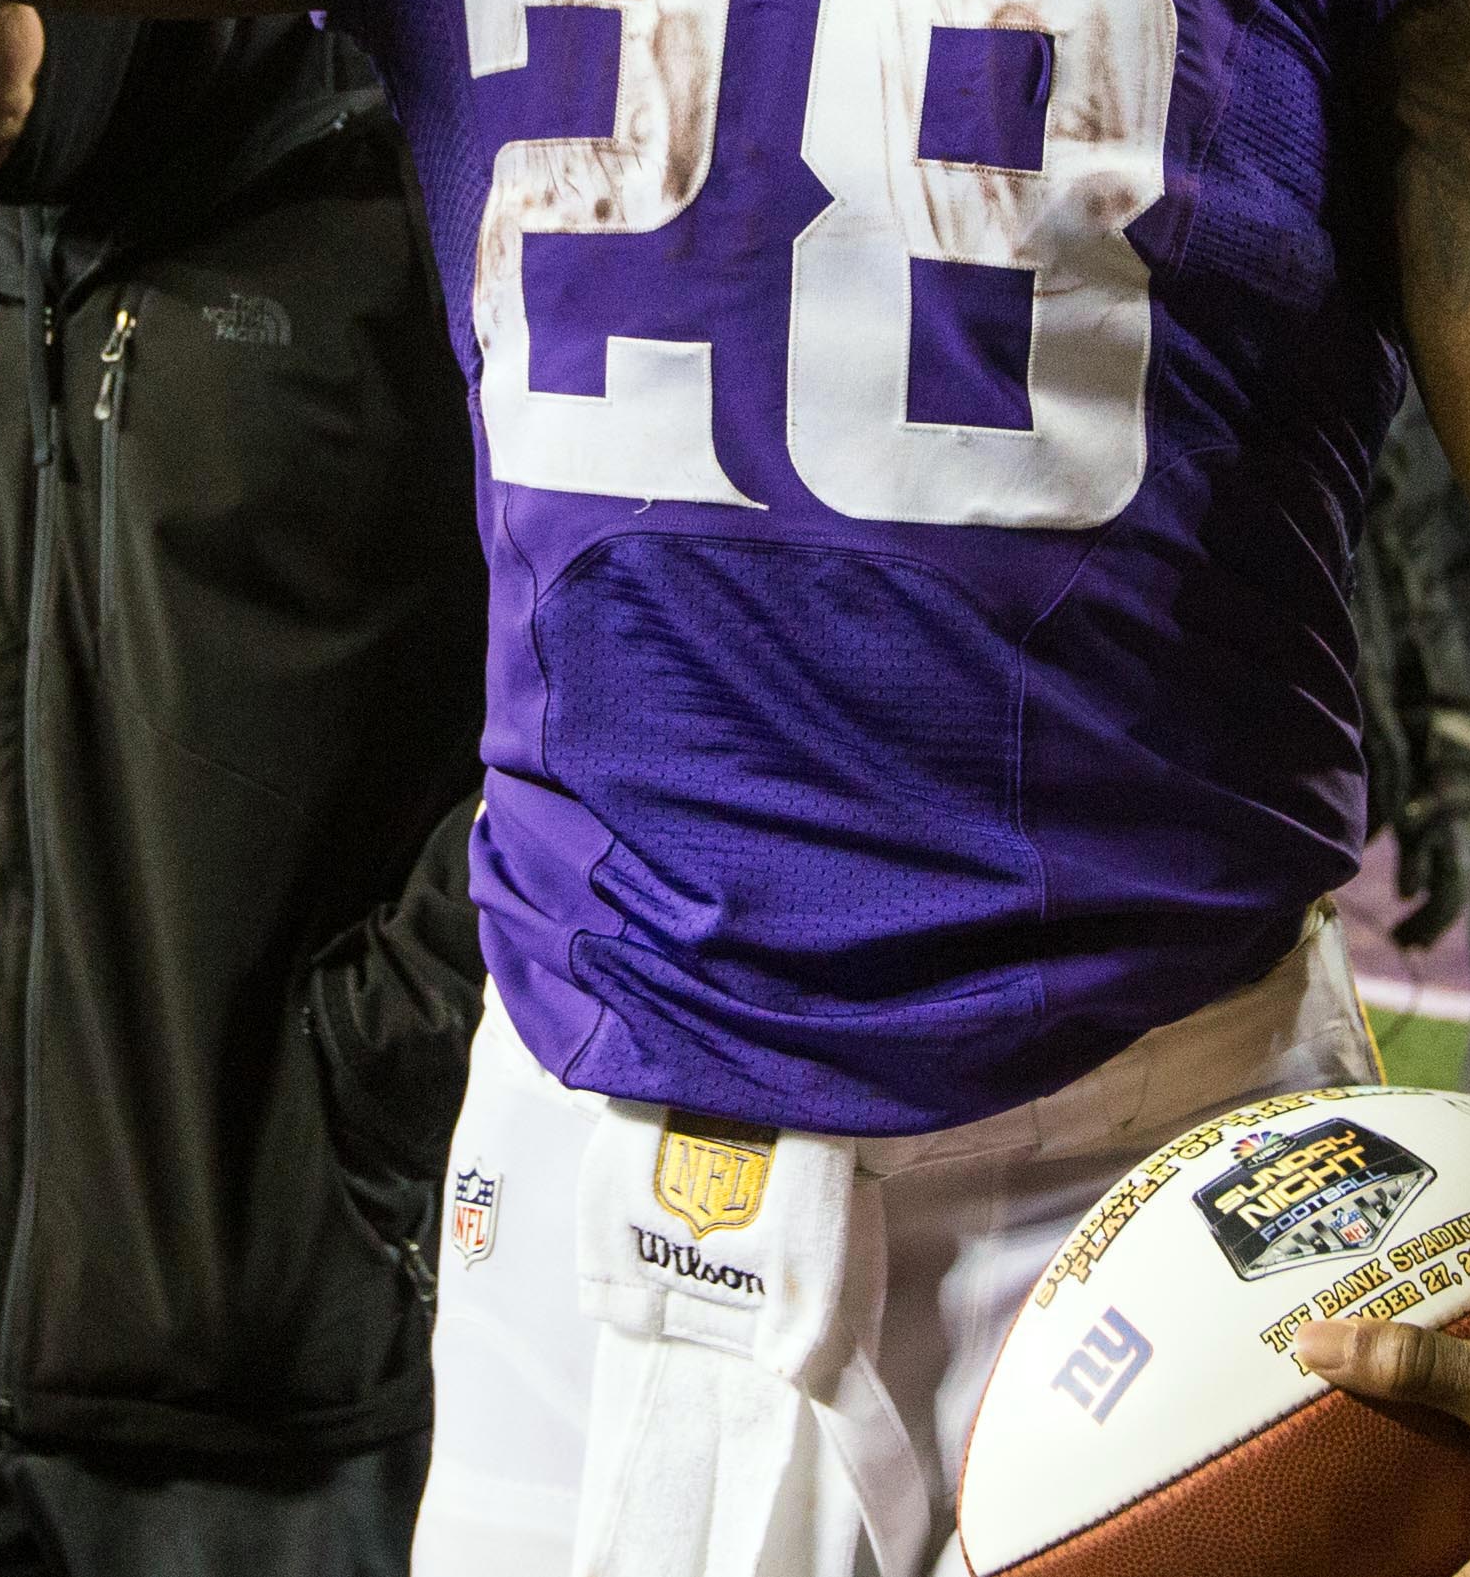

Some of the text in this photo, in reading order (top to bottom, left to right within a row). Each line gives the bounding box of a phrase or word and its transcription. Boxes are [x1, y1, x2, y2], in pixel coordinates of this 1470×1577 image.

[668, 1140, 768, 1216] NFL
[1214, 1130, 1357, 1215] SUNDAY
[1237, 1146, 1366, 1228] NIGHT
[1253, 1141, 1289, 1166] NBC
[454, 1206, 487, 1248] NFL
[1068, 1163, 1181, 1285] PLAYER
[1178, 1128, 1225, 1159] OF
[1260, 1170, 1388, 1242] FOOTBALL
[1343, 1219, 1370, 1243] NFL
[630, 1225, 766, 1295] Wilson
[1313, 1257, 1392, 1318] BANK
[1420, 1261, 1463, 1295] 27,
